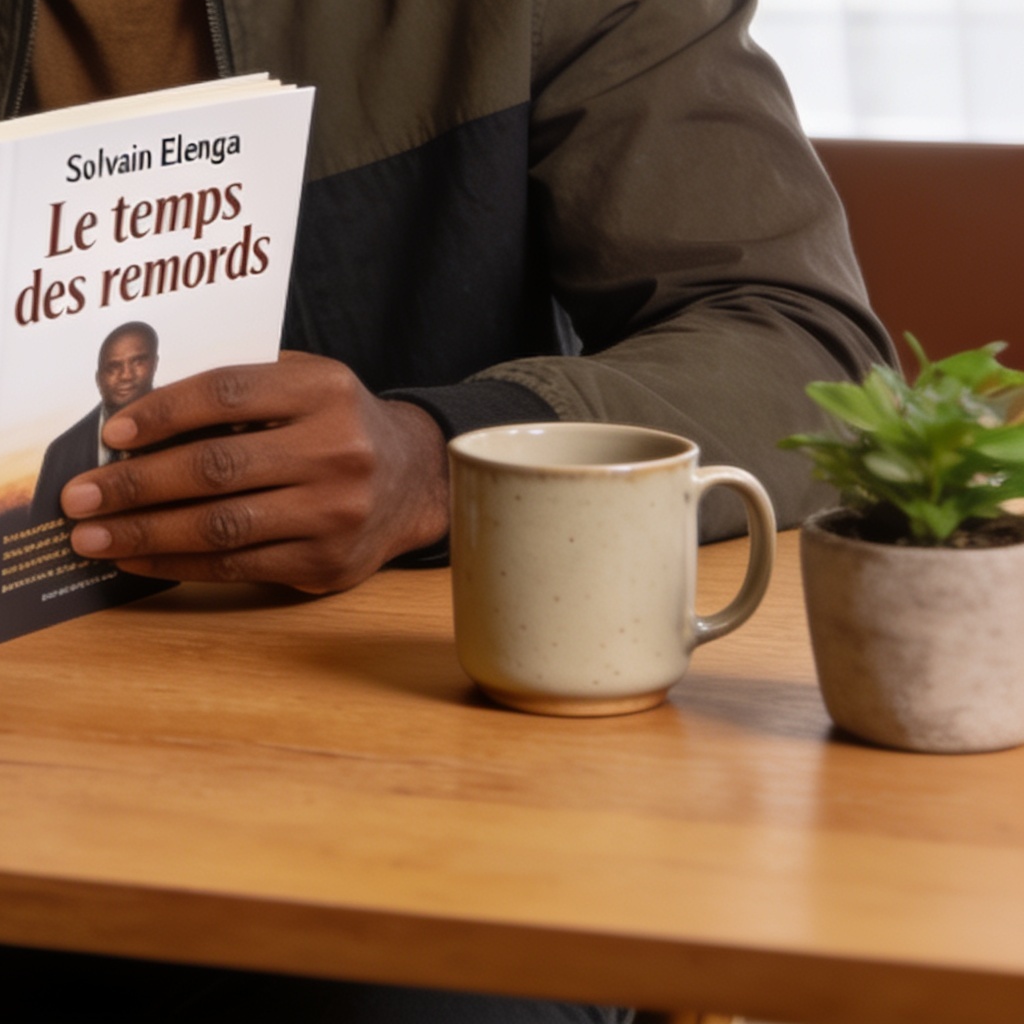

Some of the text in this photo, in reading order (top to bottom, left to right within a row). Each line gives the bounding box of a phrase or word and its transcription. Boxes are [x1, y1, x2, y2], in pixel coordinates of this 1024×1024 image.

[66, 134, 241, 183] Solvain Elenga
[45, 182, 243, 258] Le temps
[14, 223, 271, 327] des remords
